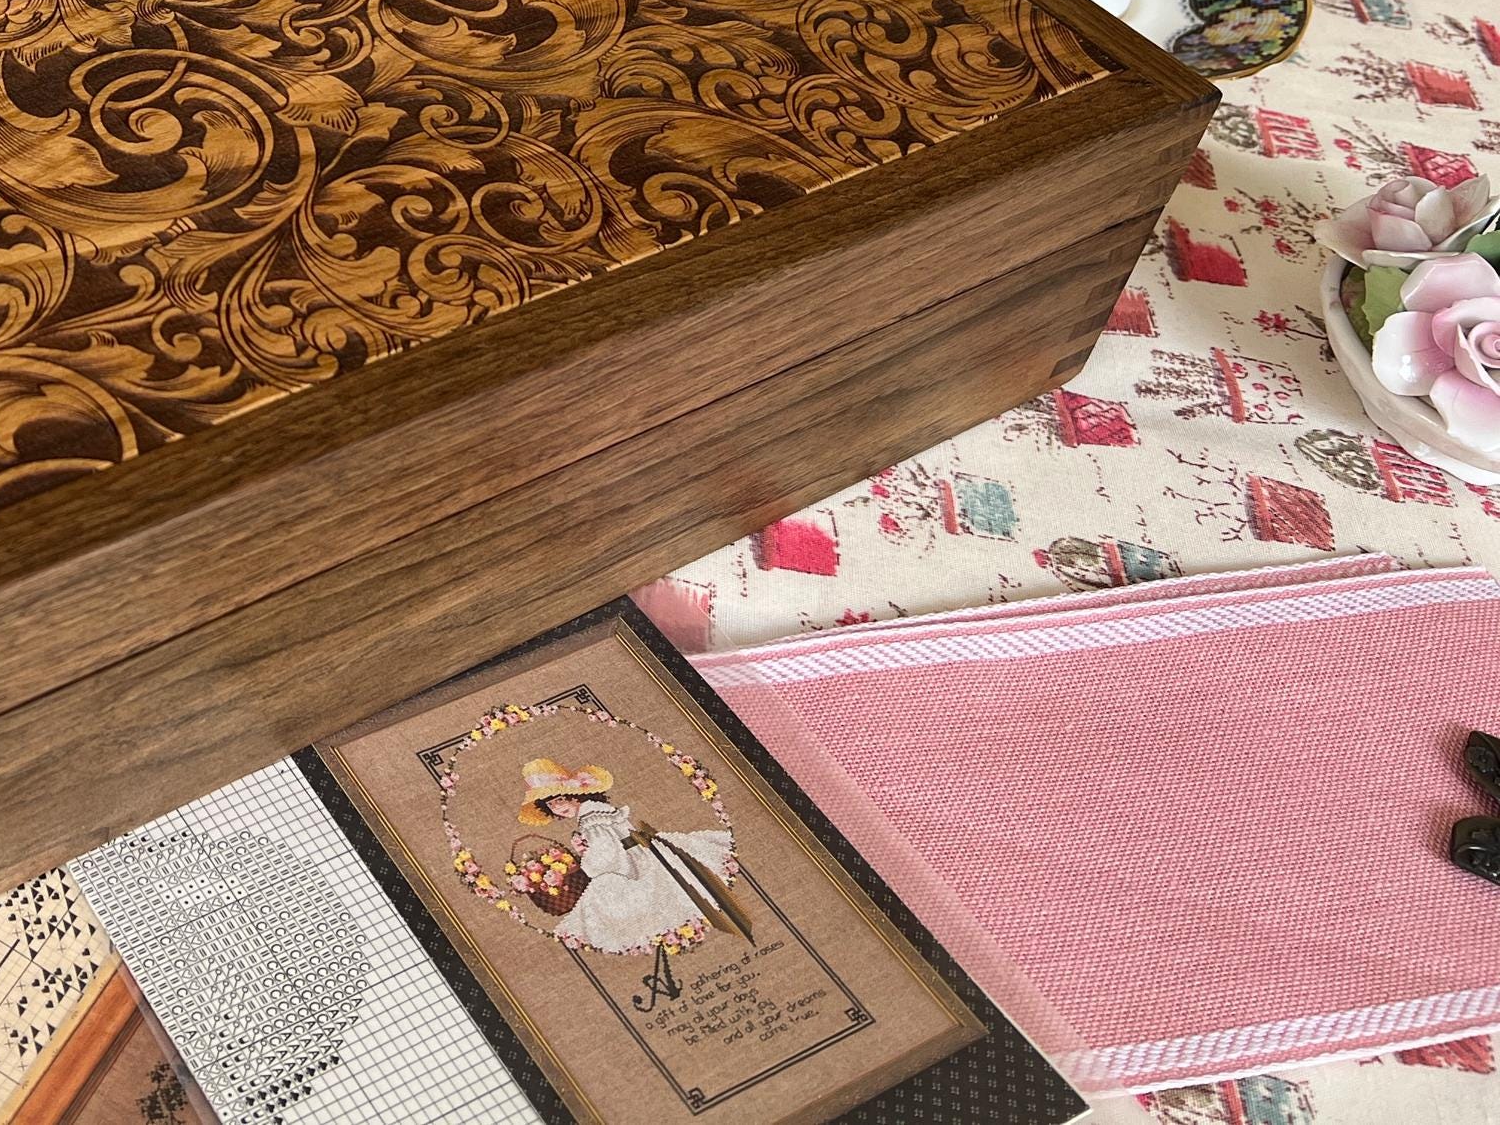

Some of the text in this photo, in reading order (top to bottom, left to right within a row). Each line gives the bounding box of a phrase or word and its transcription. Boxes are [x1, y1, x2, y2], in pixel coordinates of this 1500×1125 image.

[632, 940, 785, 1013] A gathering of roses
[645, 972, 760, 1030] a gift of love for you.
[667, 988, 759, 1036] may all your days
[683, 1035, 699, 1046] be
[728, 1005, 753, 1024] with
[757, 997, 776, 1016] joy
[723, 989, 827, 1044] and all your dreams
[759, 1010, 820, 1041] come true.
